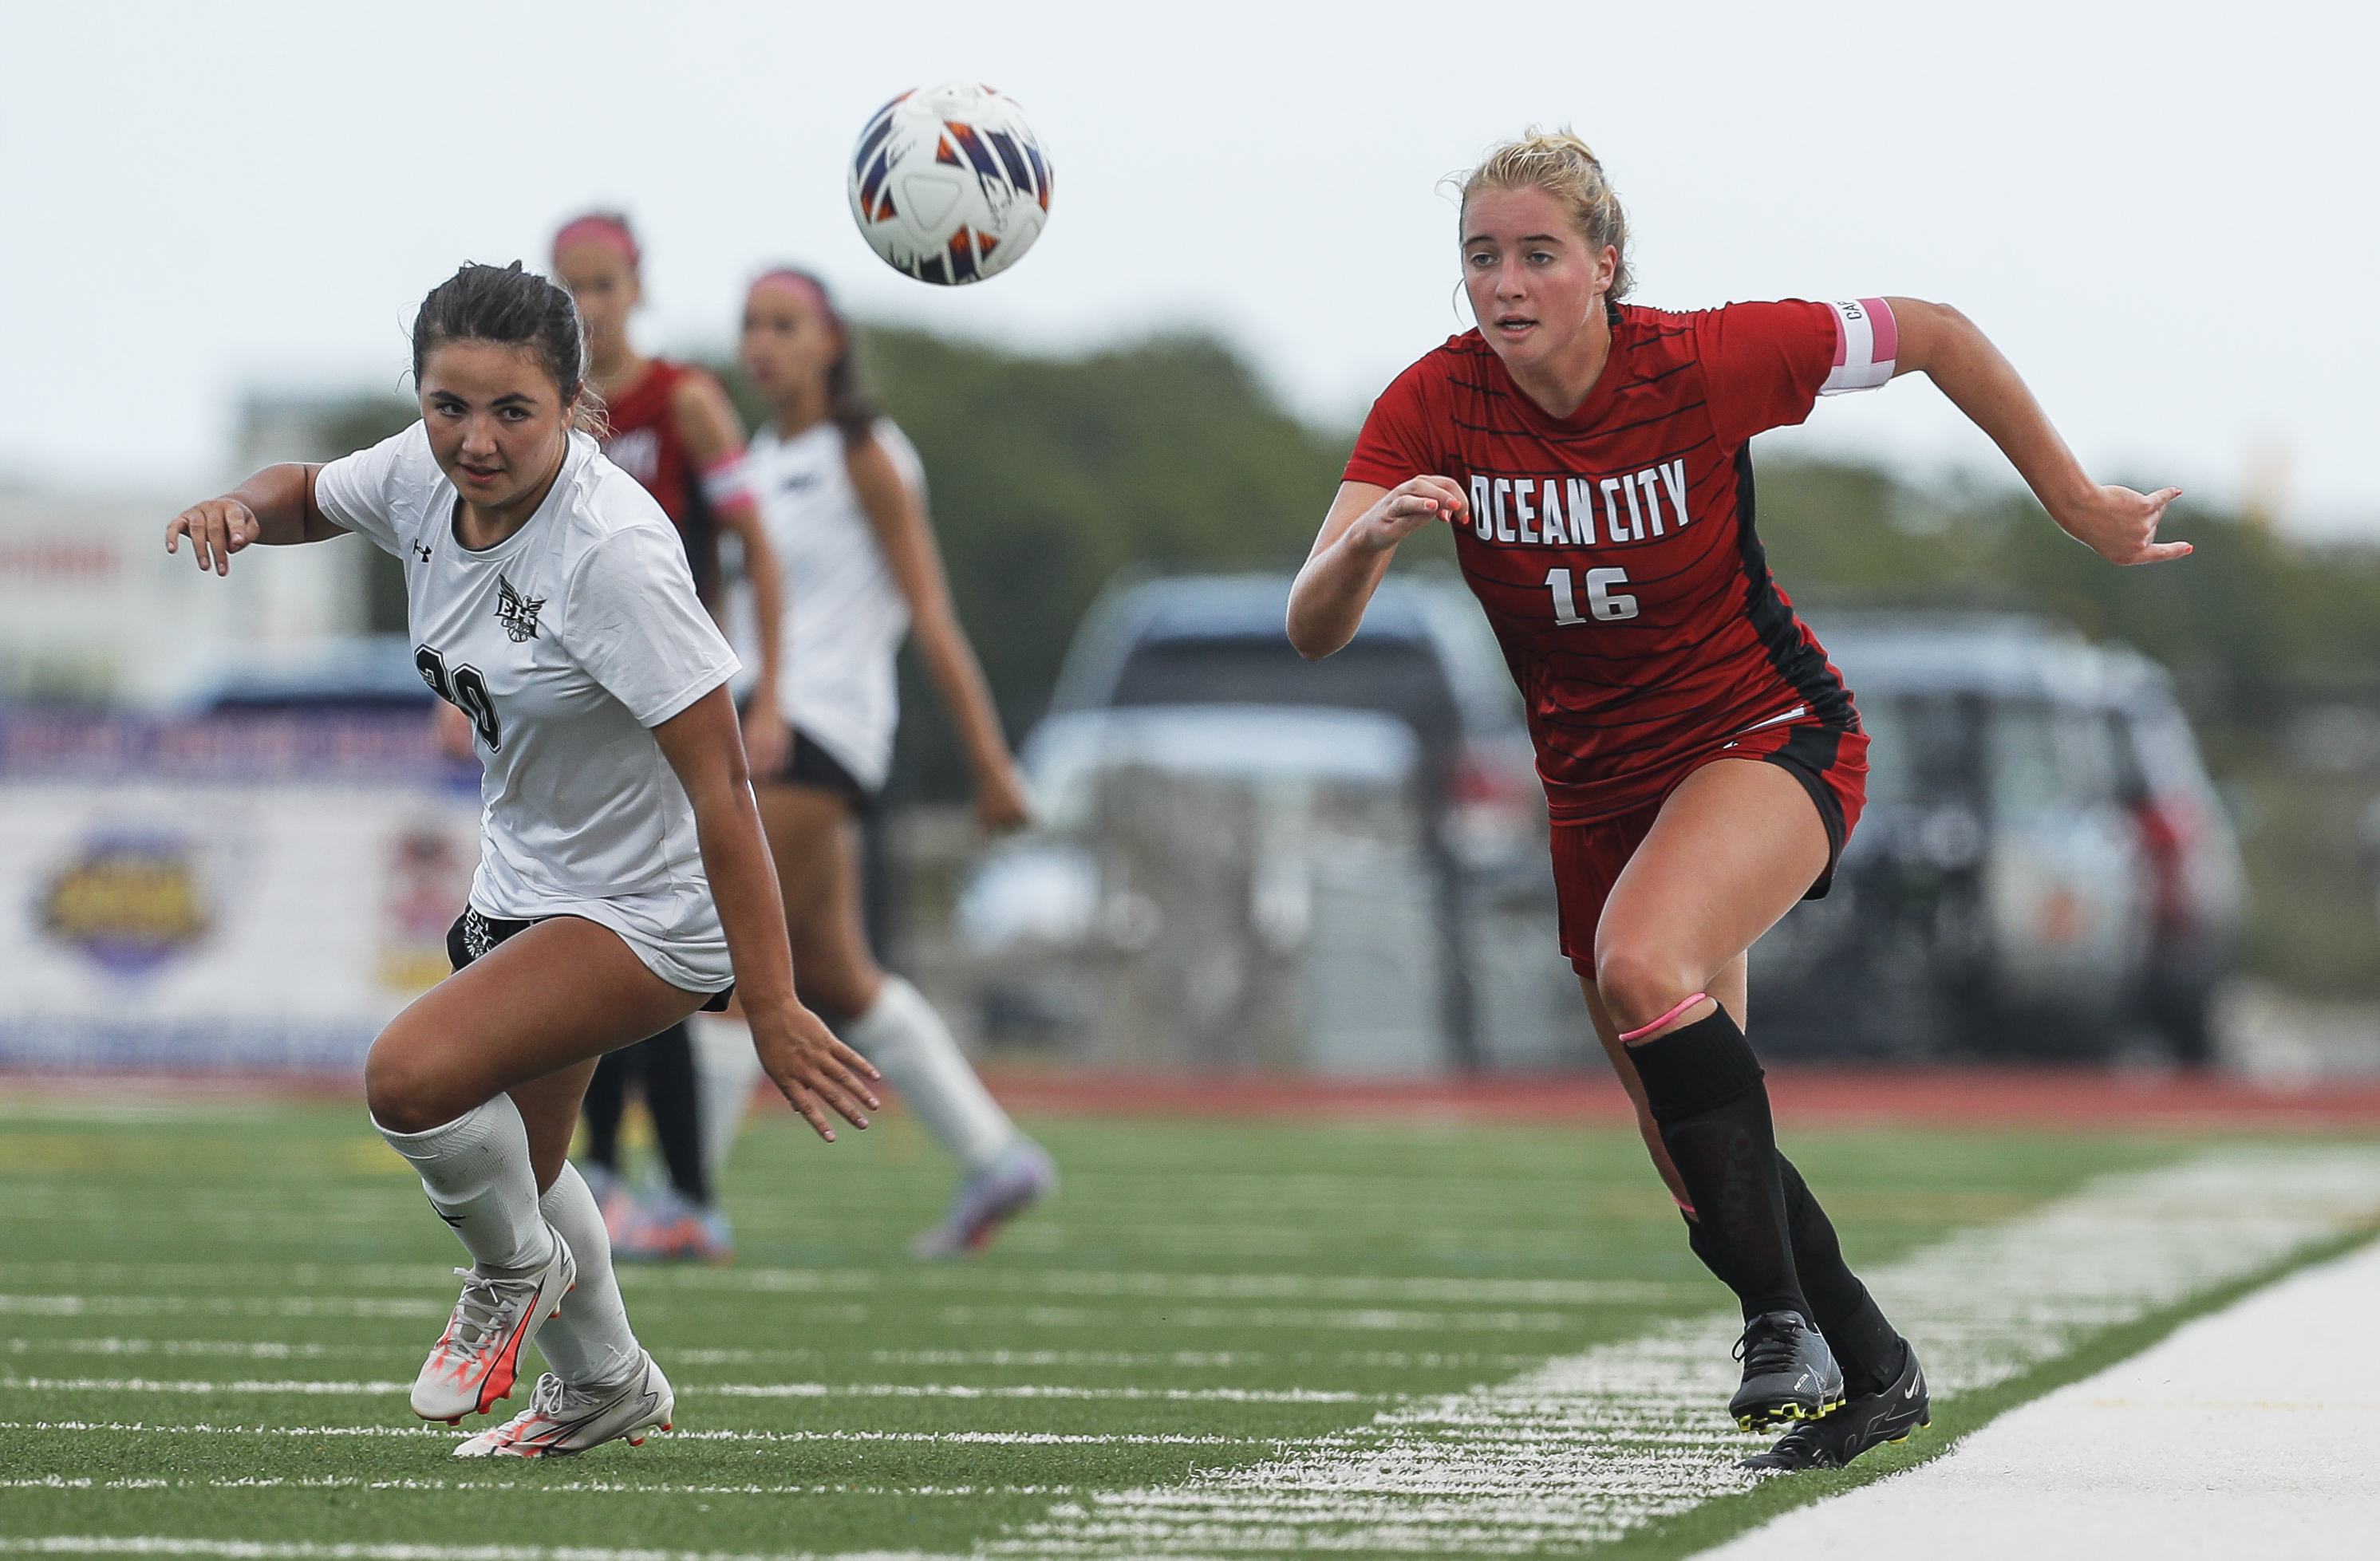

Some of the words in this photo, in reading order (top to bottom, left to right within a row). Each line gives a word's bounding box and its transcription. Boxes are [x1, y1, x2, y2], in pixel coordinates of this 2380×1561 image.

[1470, 474, 1596, 545] OCEAN
[1599, 458, 1689, 543] CITY
[1544, 566, 1640, 626] 16
